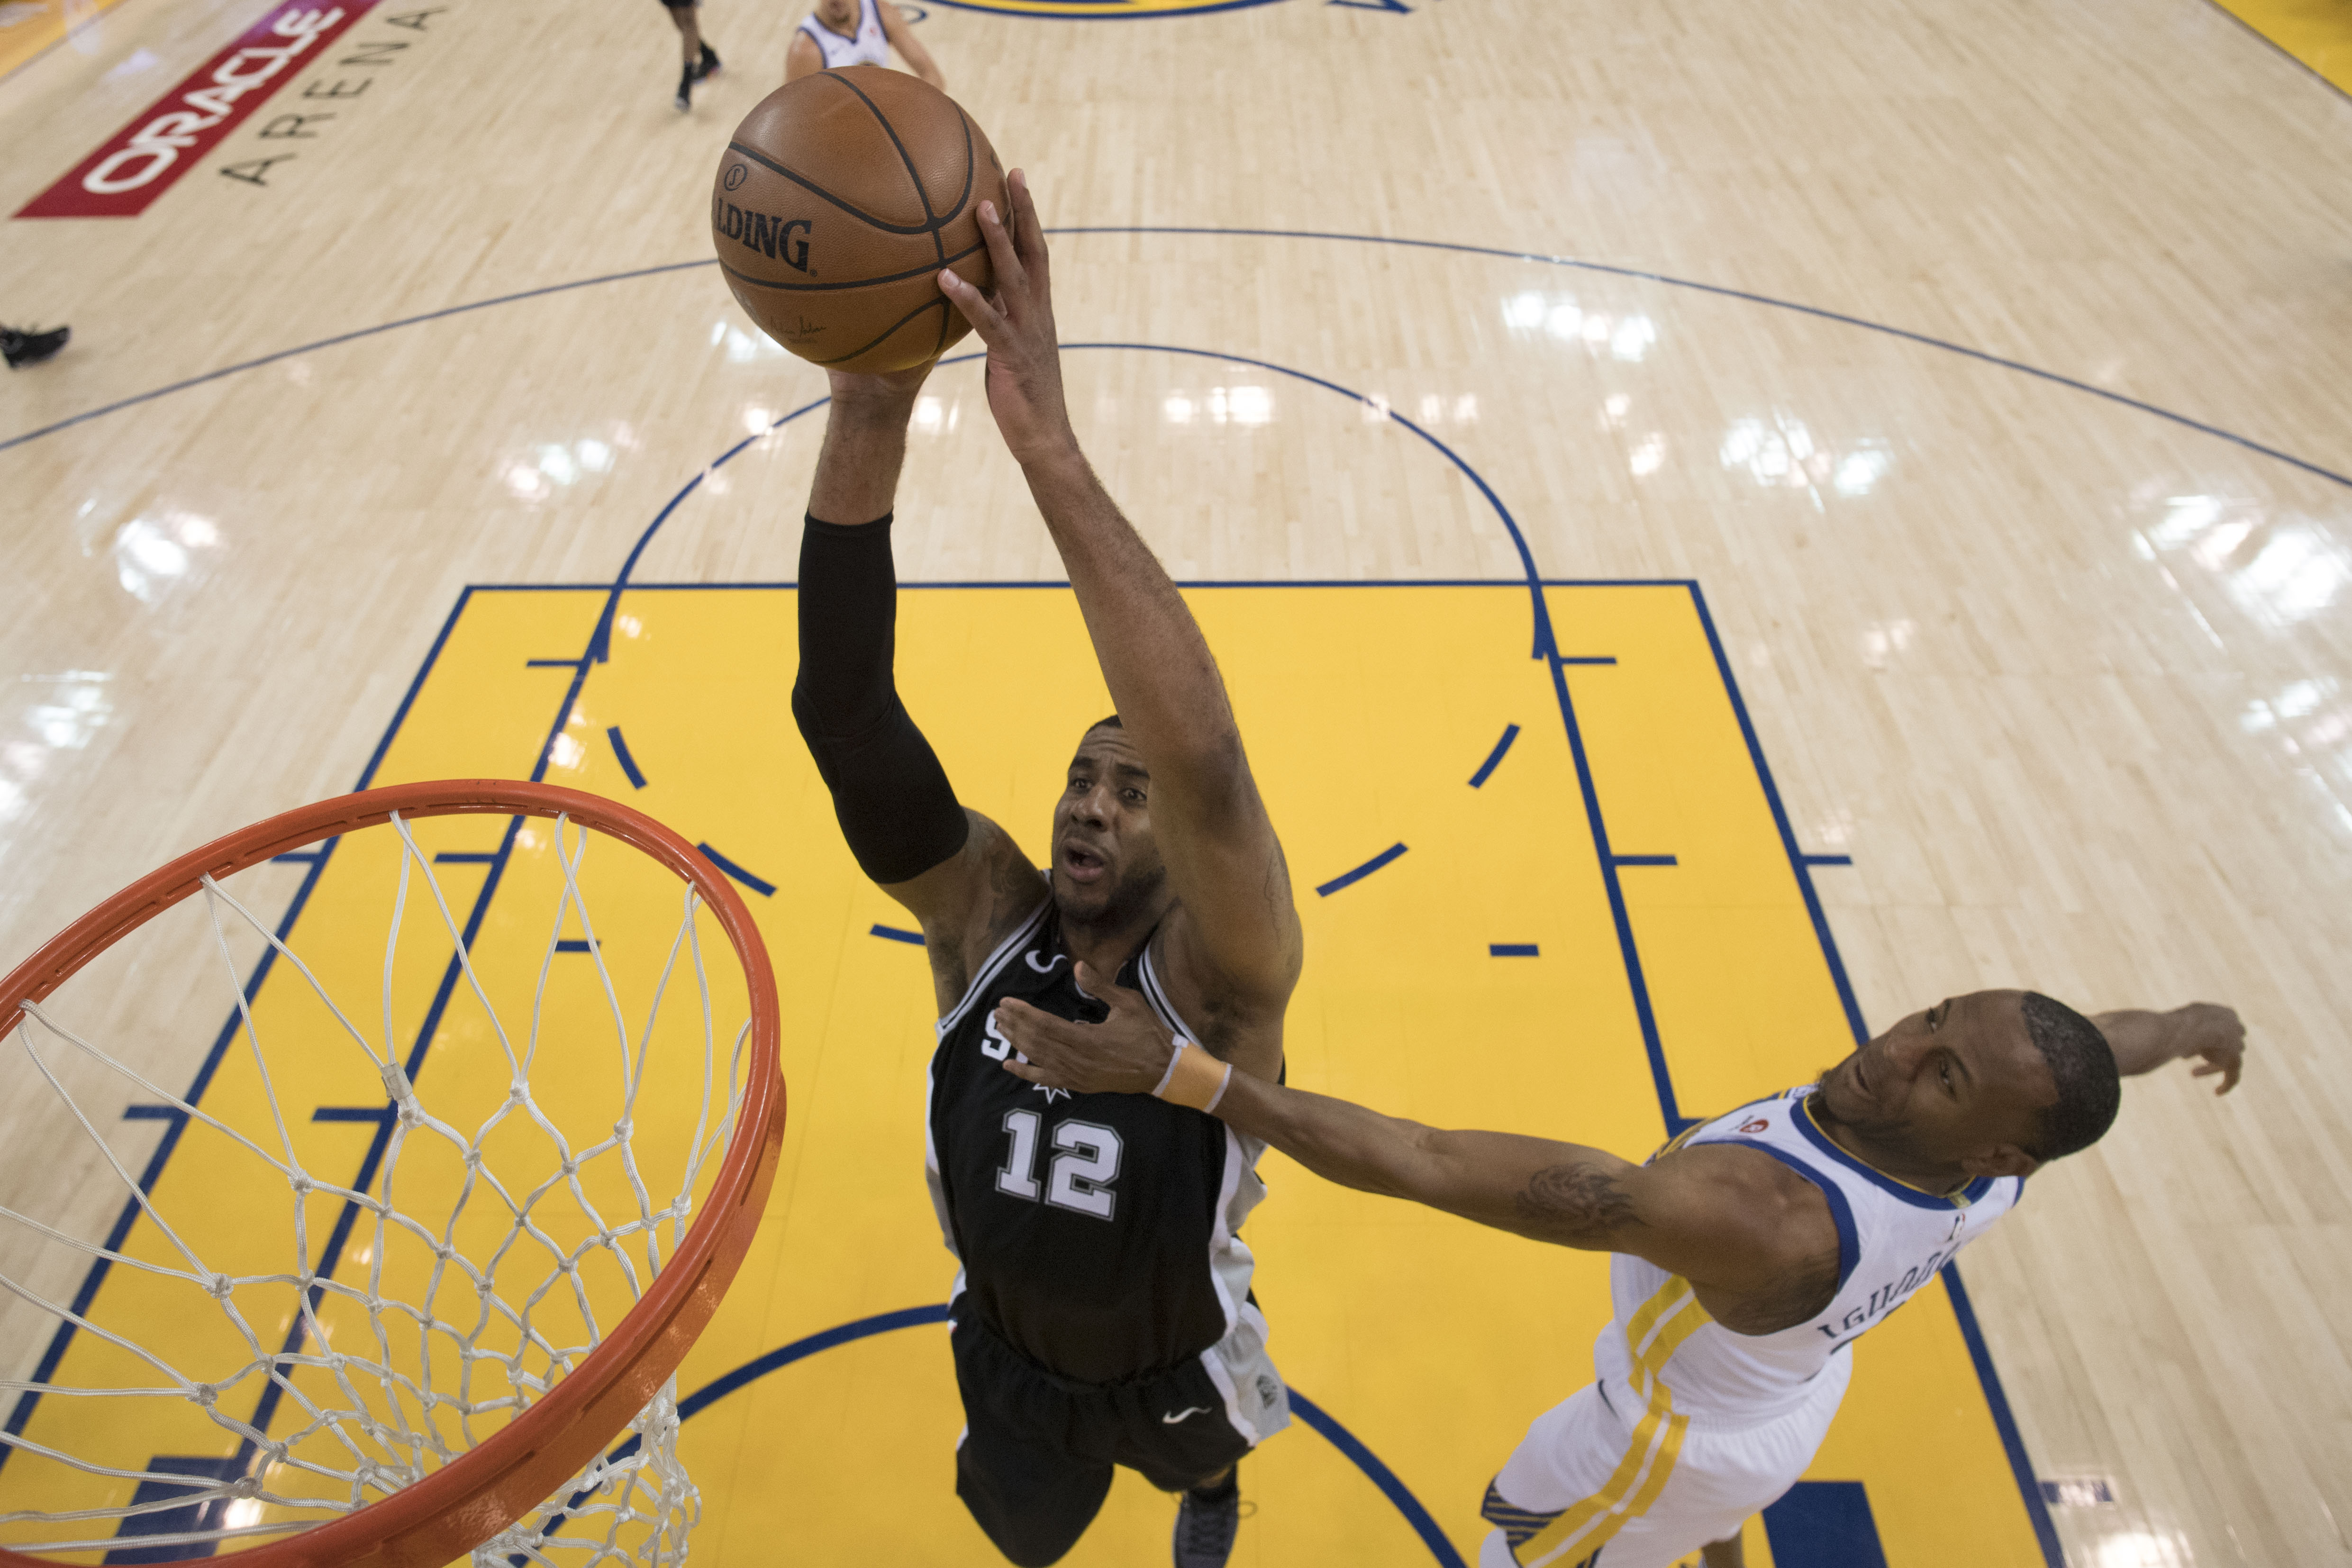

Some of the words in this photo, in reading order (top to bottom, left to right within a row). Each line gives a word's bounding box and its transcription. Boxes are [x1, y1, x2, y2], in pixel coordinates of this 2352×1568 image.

[82, 7, 346, 194] ORACLE
[218, 4, 449, 187] ARENA
[995, 1107, 1124, 1222] 12
